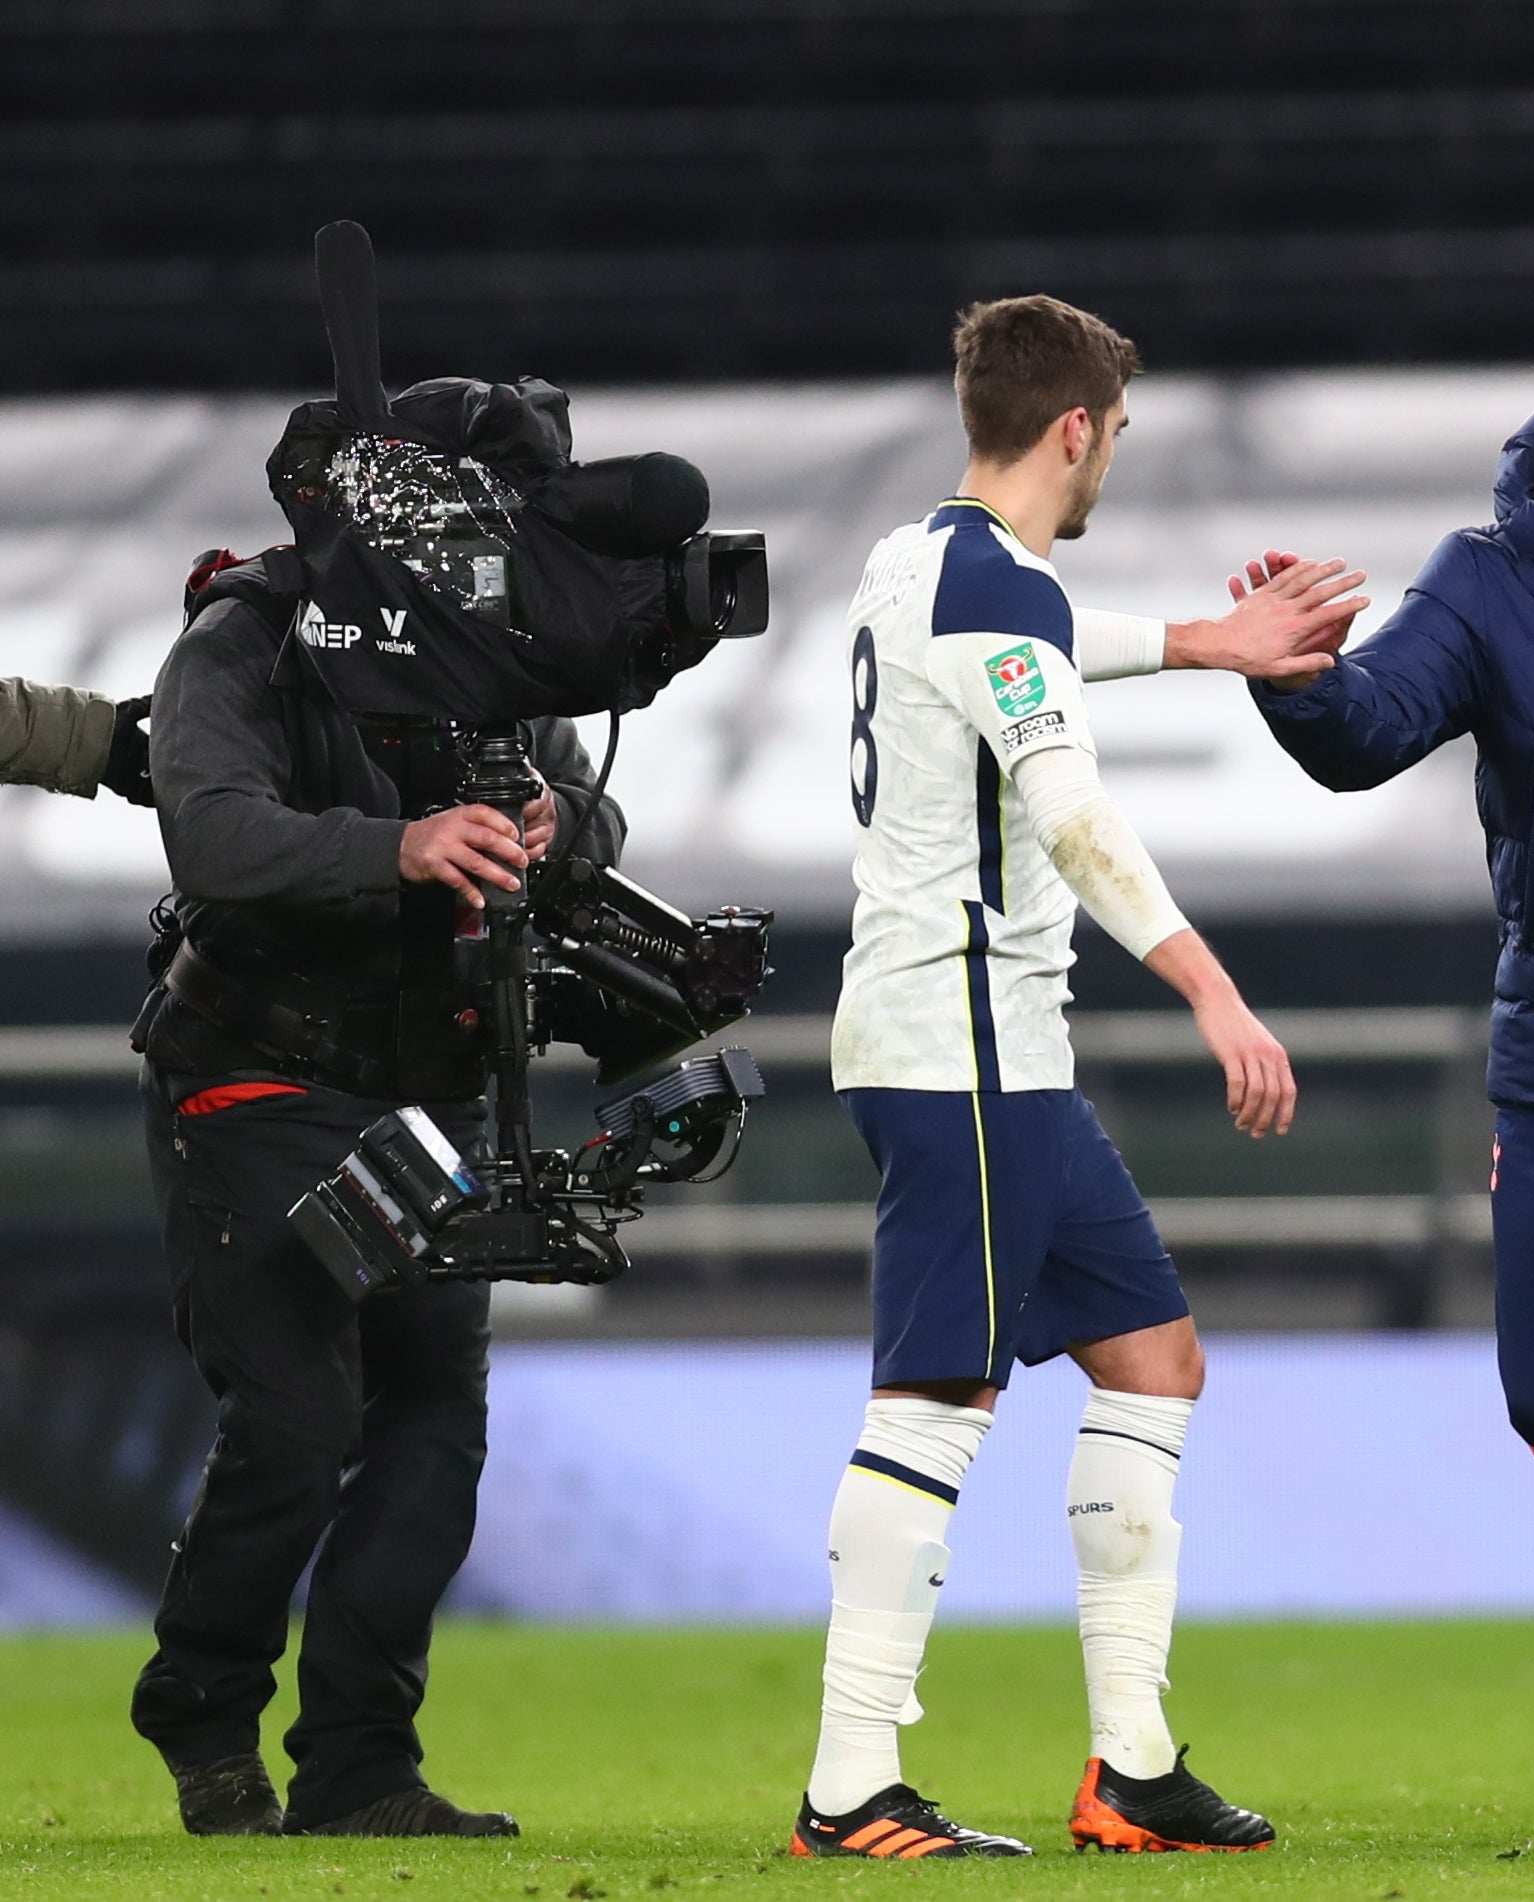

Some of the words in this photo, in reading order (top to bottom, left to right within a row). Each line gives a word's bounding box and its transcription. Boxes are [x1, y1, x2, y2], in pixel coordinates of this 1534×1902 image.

[311, 623, 362, 649] NEP
[1009, 683, 1032, 702] Cup
[851, 625, 879, 829] 8
[1019, 713, 1059, 735] room
[1067, 1502, 1114, 1517] SPURS
